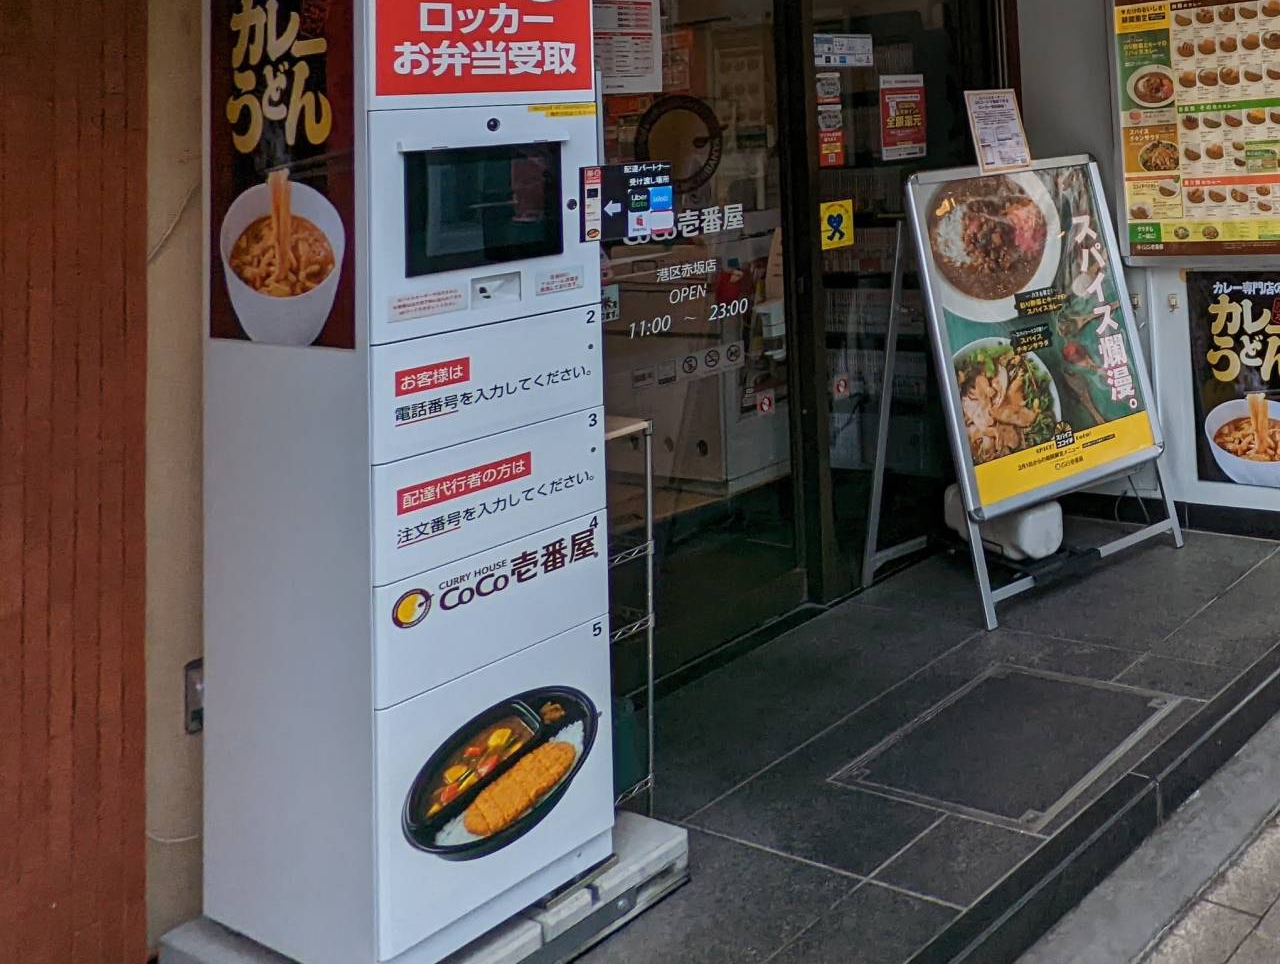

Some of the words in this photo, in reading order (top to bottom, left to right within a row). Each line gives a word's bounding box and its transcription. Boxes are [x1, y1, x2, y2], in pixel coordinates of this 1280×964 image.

[418, 2, 555, 35] ロッカー
[393, 41, 577, 77] お弁当受取
[226, 60, 333, 154] うどん
[629, 176, 670, 186] 受け渡し場所
[656, 259, 717, 283] 港区赤坂店
[669, 284, 707, 304] OPEN
[586, 310, 595, 324] 2
[629, 315, 672, 339] 11:00
[708, 298, 749, 321] 23:00
[1020, 334, 1043, 344] スパイス
[400, 365, 463, 390] お客様は
[395, 366, 592, 422] 電話番号を入力してください。
[588, 413, 597, 427] 3
[403, 460, 525, 509] 配達代行者の方は
[397, 471, 594, 545] 注文番号を入力してください。
[589, 516, 598, 528] 4
[439, 572, 471, 589] CURRY
[474, 559, 507, 578] HOUSE
[440, 528, 595, 610] CoCo壱番屋
[592, 622, 602, 636] 5
